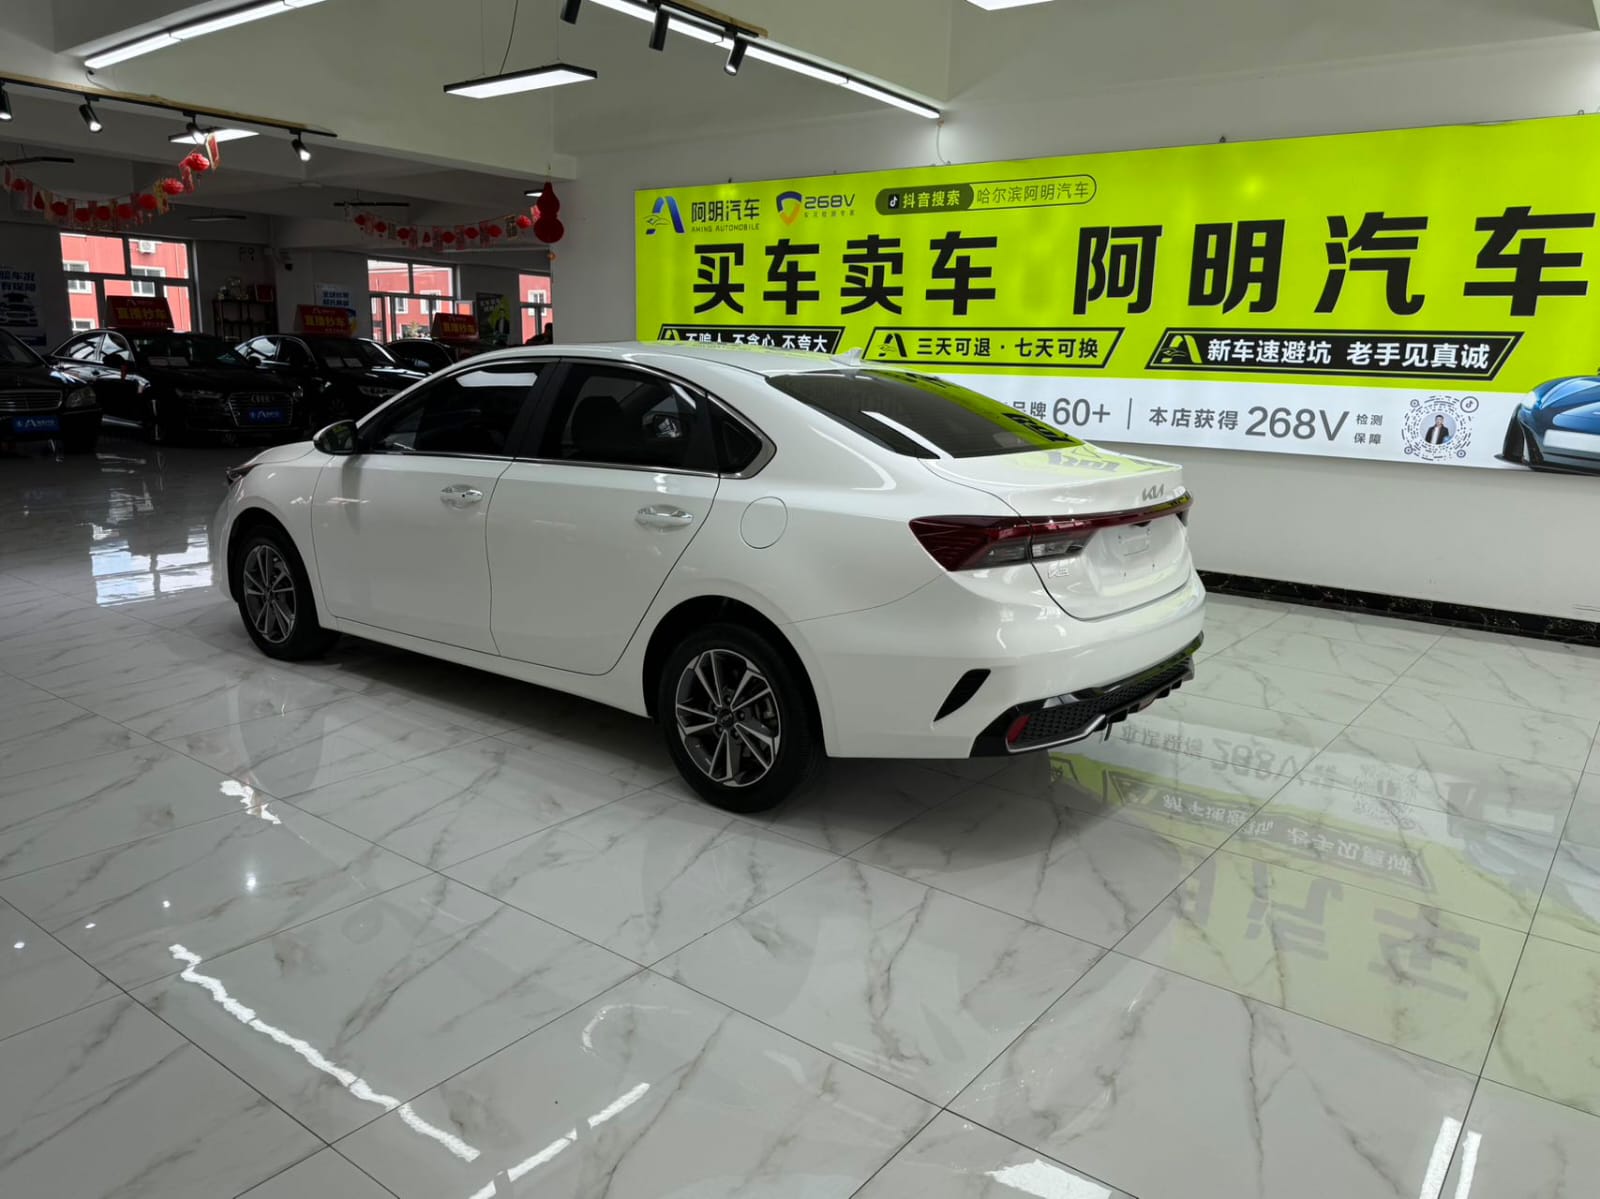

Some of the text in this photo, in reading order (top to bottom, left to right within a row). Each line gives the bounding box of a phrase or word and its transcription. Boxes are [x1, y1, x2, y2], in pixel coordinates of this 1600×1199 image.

[804, 193, 856, 209] 268V
[902, 181, 1089, 209] 抖音搜索 哈尔滨阿明汽车
[691, 198, 760, 224] 阿明汽车
[715, 223, 760, 233] AUTOMOBILE
[692, 206, 1596, 317] 买车卖车 阿明汽车
[782, 334, 828, 353] 不夸大
[1207, 338, 1491, 370] 新车速避坑 老手见真诚
[1053, 397, 1111, 426] 60+
[1148, 406, 1350, 442] 本店获得 268V
[1356, 413, 1383, 426] 检测
[1354, 432, 1382, 445] 保障
